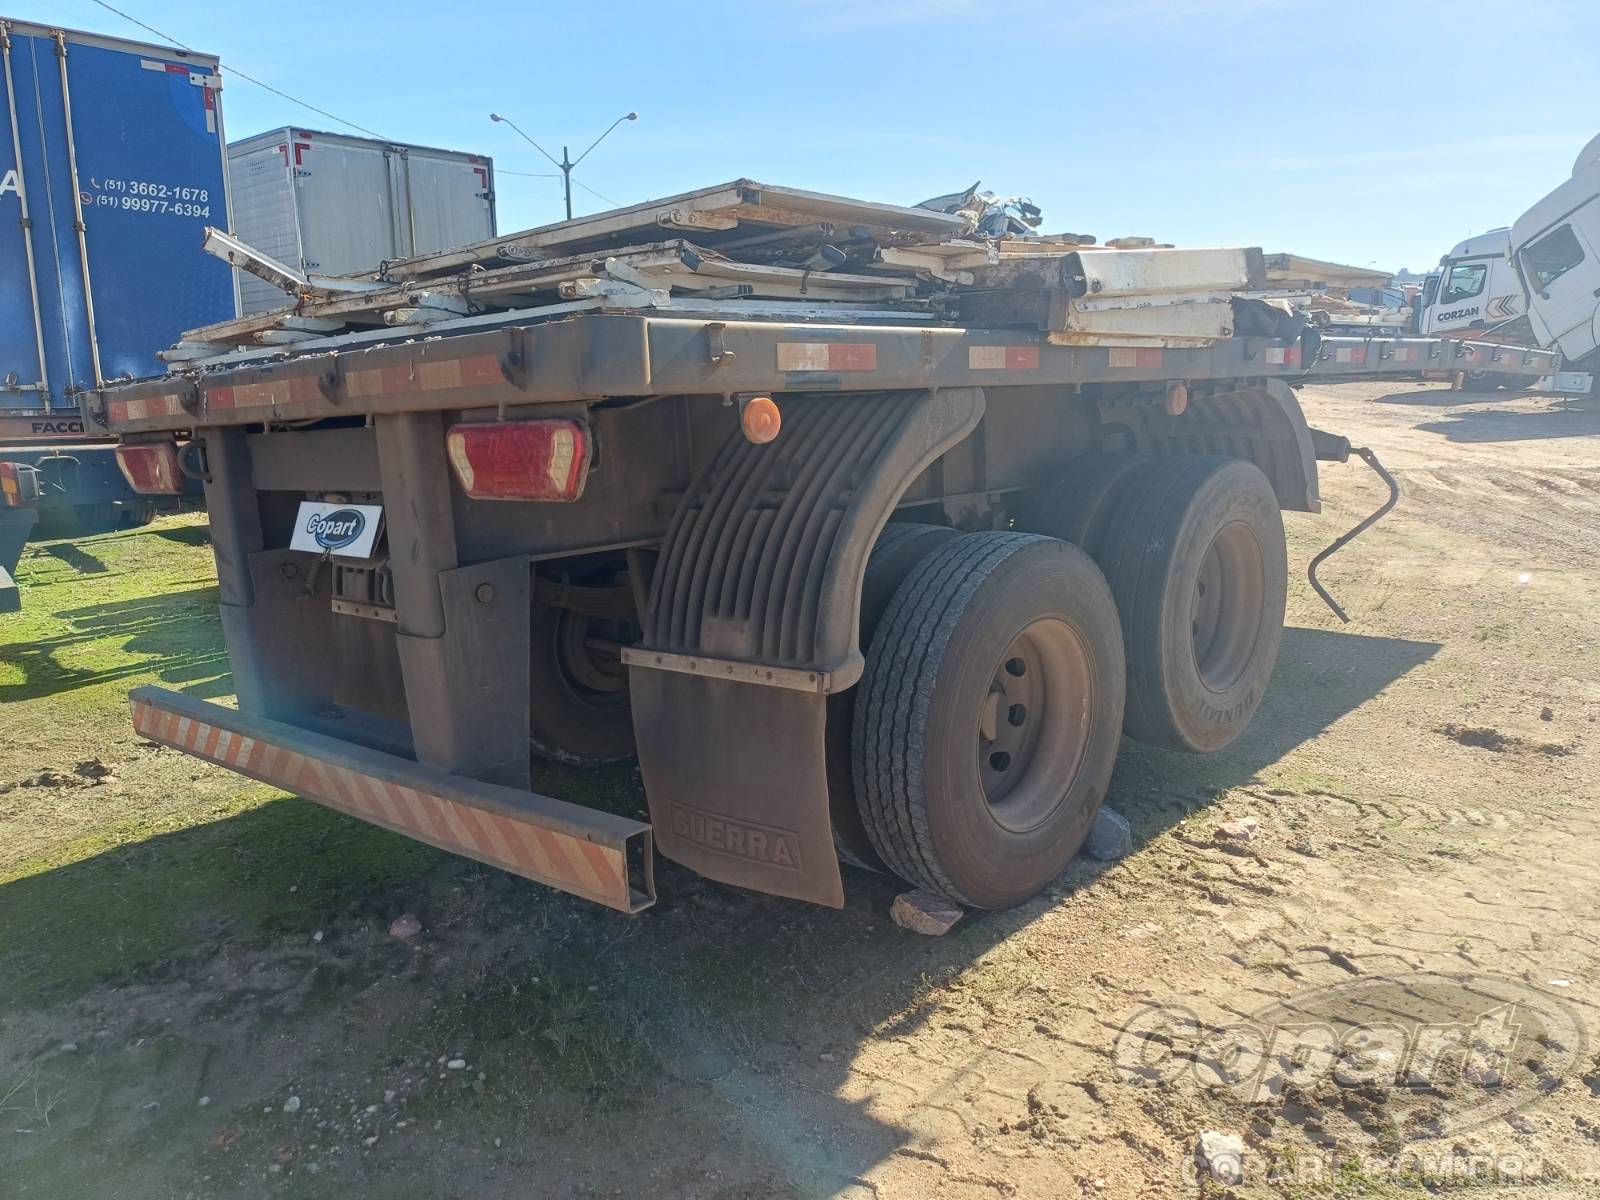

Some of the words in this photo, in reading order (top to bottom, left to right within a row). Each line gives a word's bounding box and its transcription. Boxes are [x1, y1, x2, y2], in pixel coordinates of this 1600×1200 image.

[104, 179, 126, 192] (51)
[129, 181, 209, 202] 3662-1678
[96, 194, 118, 208] (51)
[122, 196, 210, 218] 99977-6394
[1437, 306, 1480, 321] CORZAN
[306, 513, 357, 539] Copart
[673, 809, 796, 866] GUERRA
